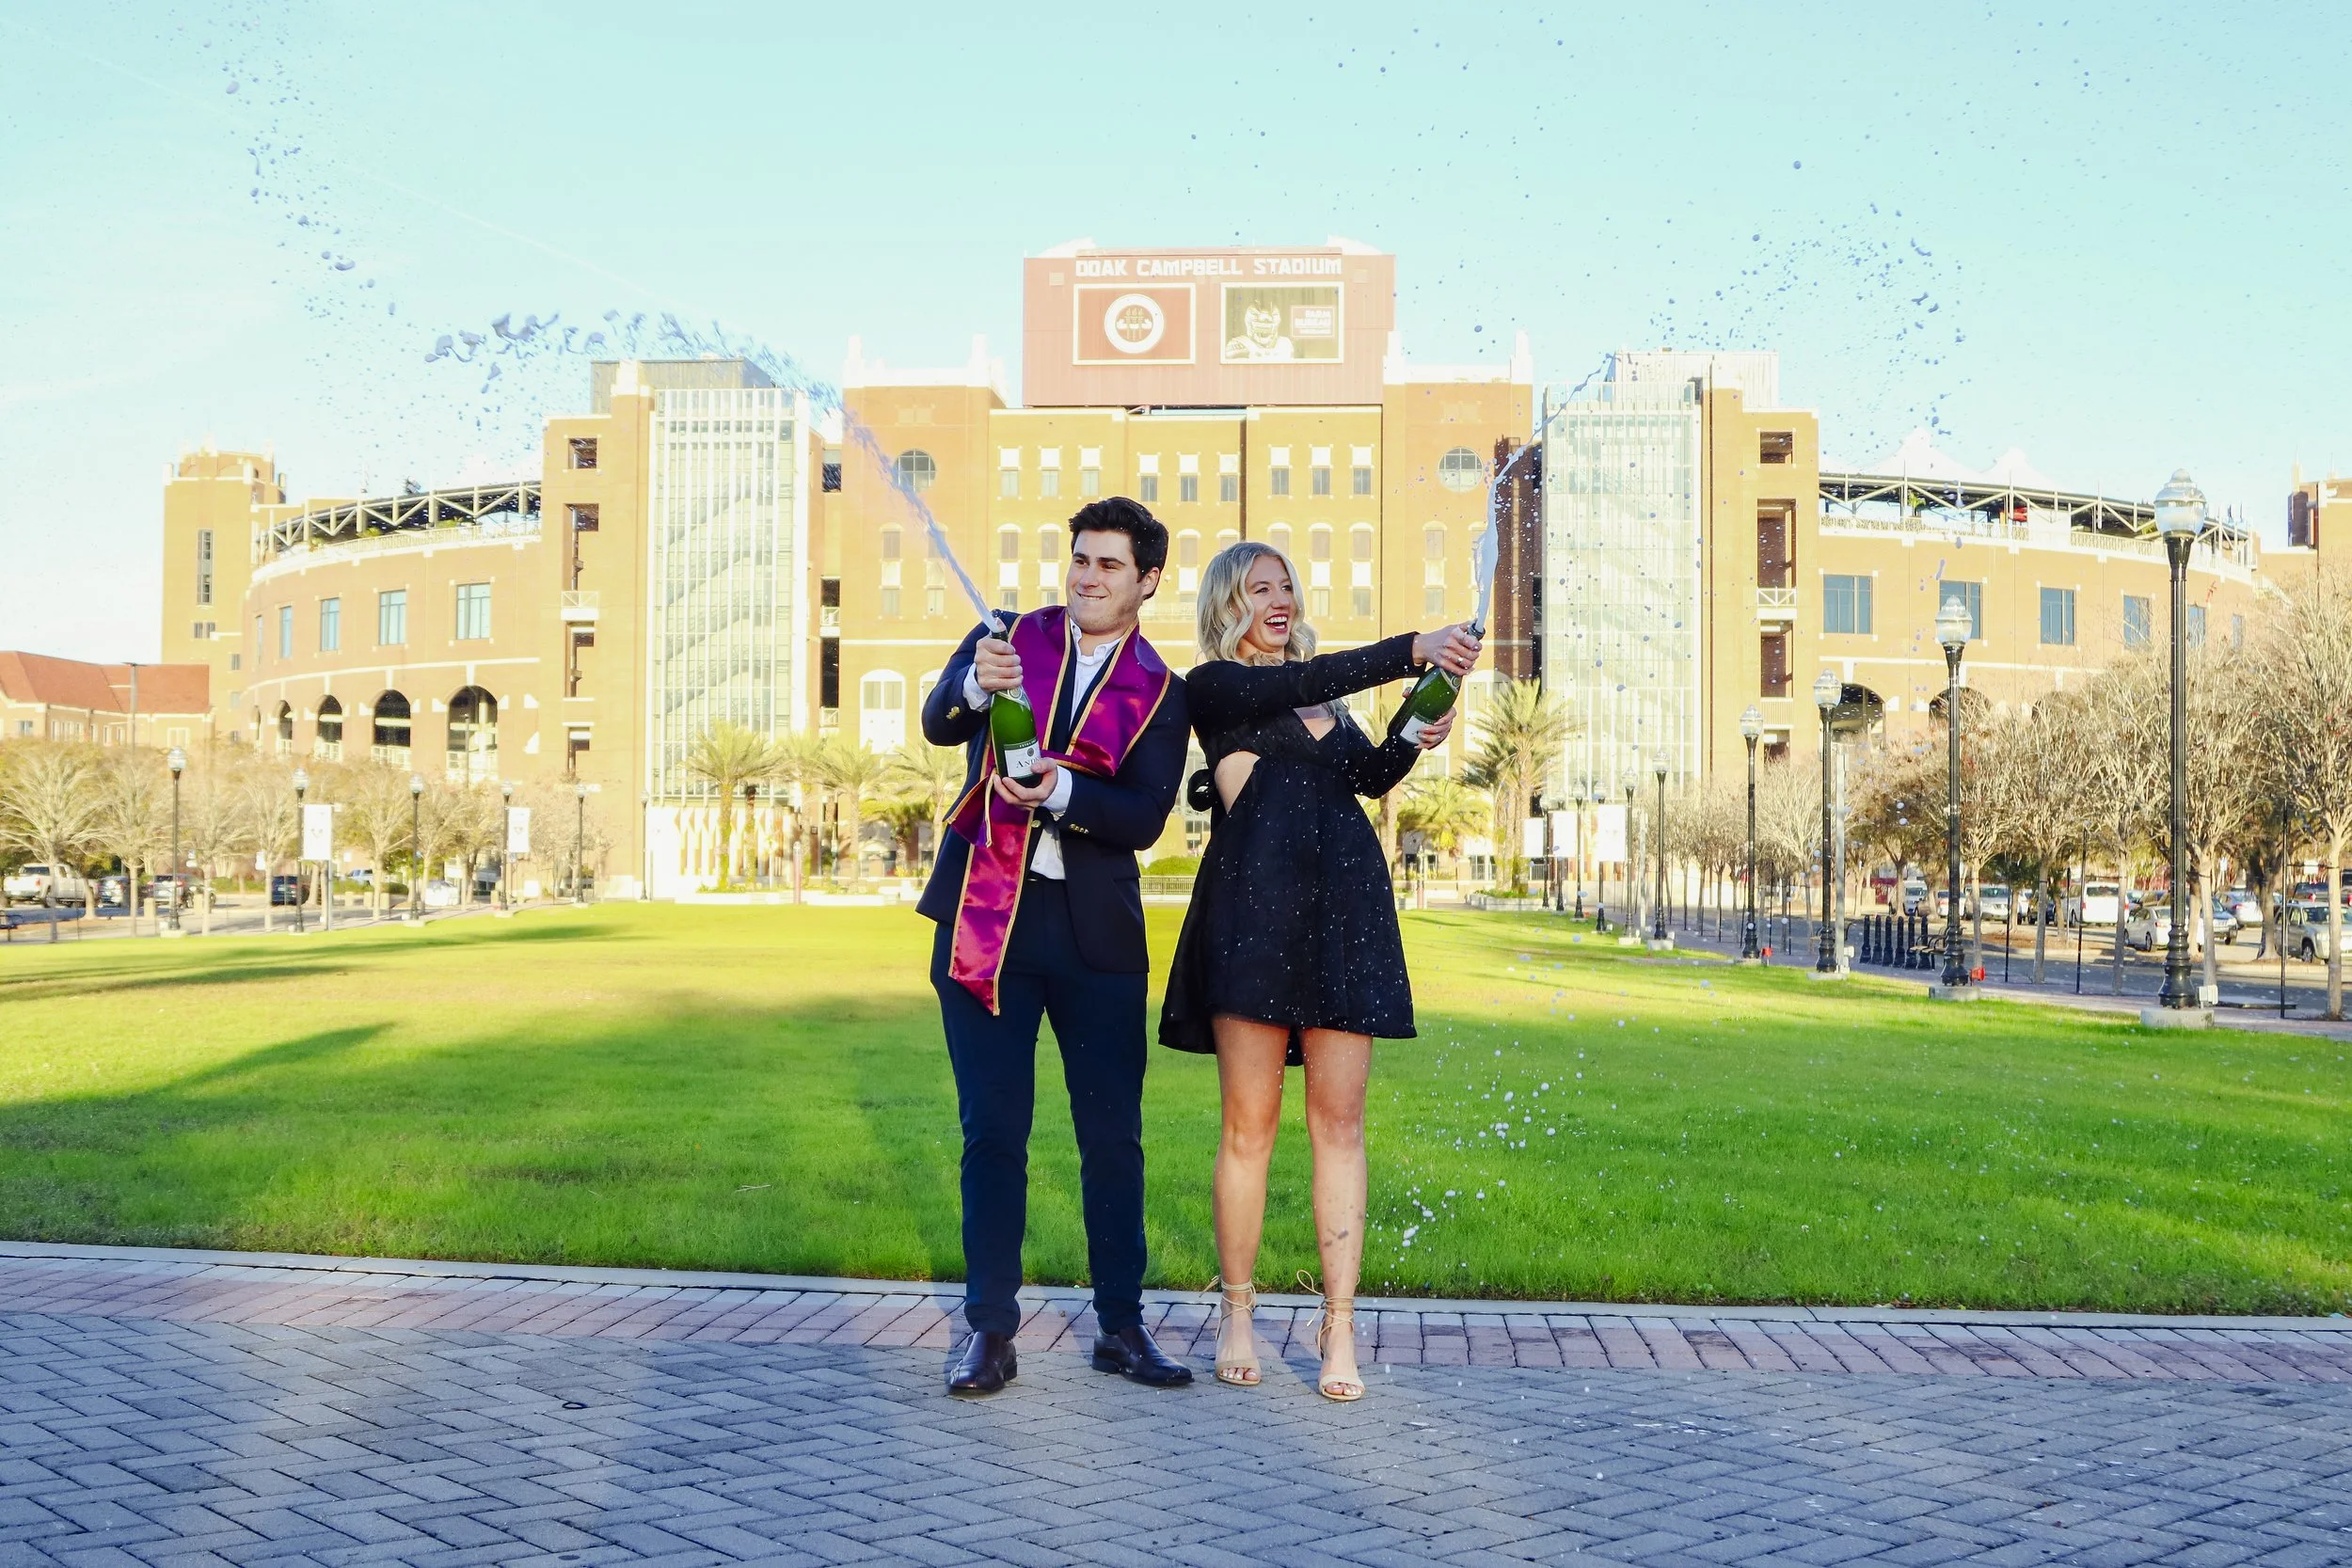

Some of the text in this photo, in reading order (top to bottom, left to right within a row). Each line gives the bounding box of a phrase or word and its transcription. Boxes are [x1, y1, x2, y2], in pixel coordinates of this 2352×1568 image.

[1075, 258, 1343, 277] DOAK CAMPBELL STADIUM
